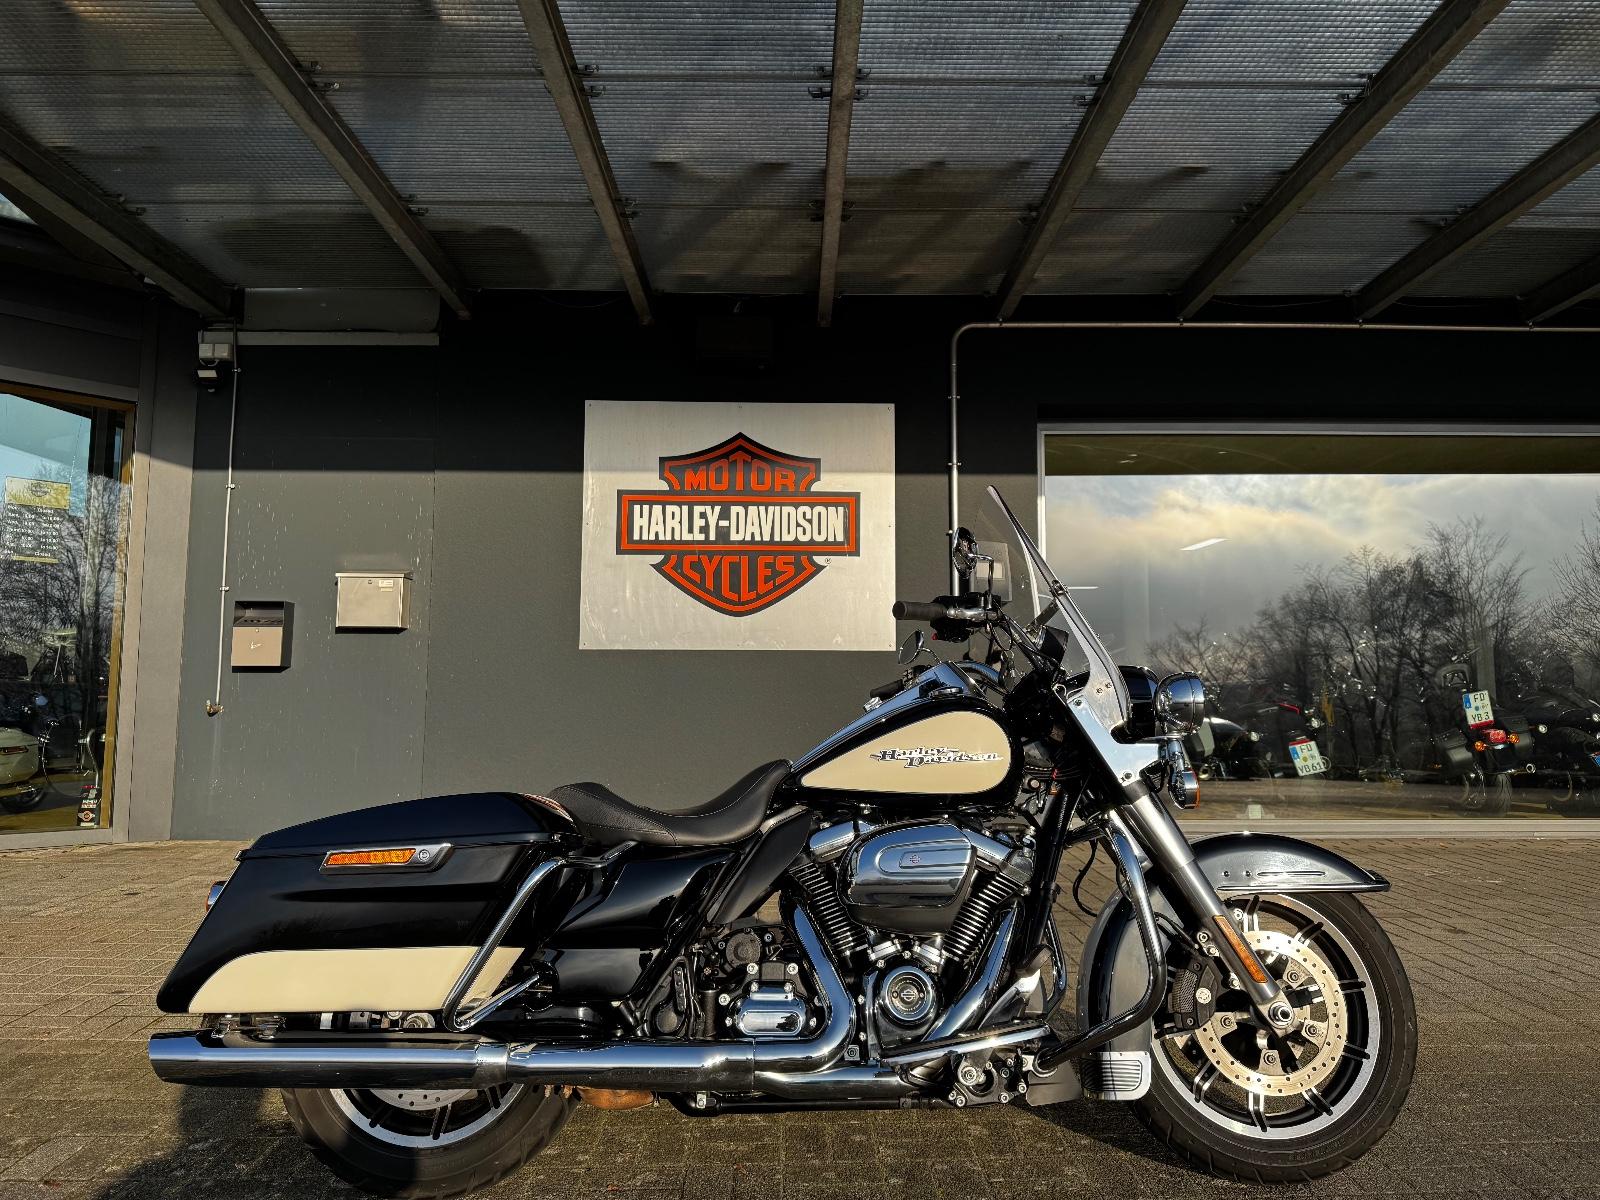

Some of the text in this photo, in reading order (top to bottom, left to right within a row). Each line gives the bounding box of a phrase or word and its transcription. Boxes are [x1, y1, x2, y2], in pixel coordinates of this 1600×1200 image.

[684, 450, 796, 492] MOTOR
[632, 504, 844, 542] HARLEY-DAVIDSON
[682, 555, 795, 602] CYCLES
[1473, 692, 1485, 703] FD
